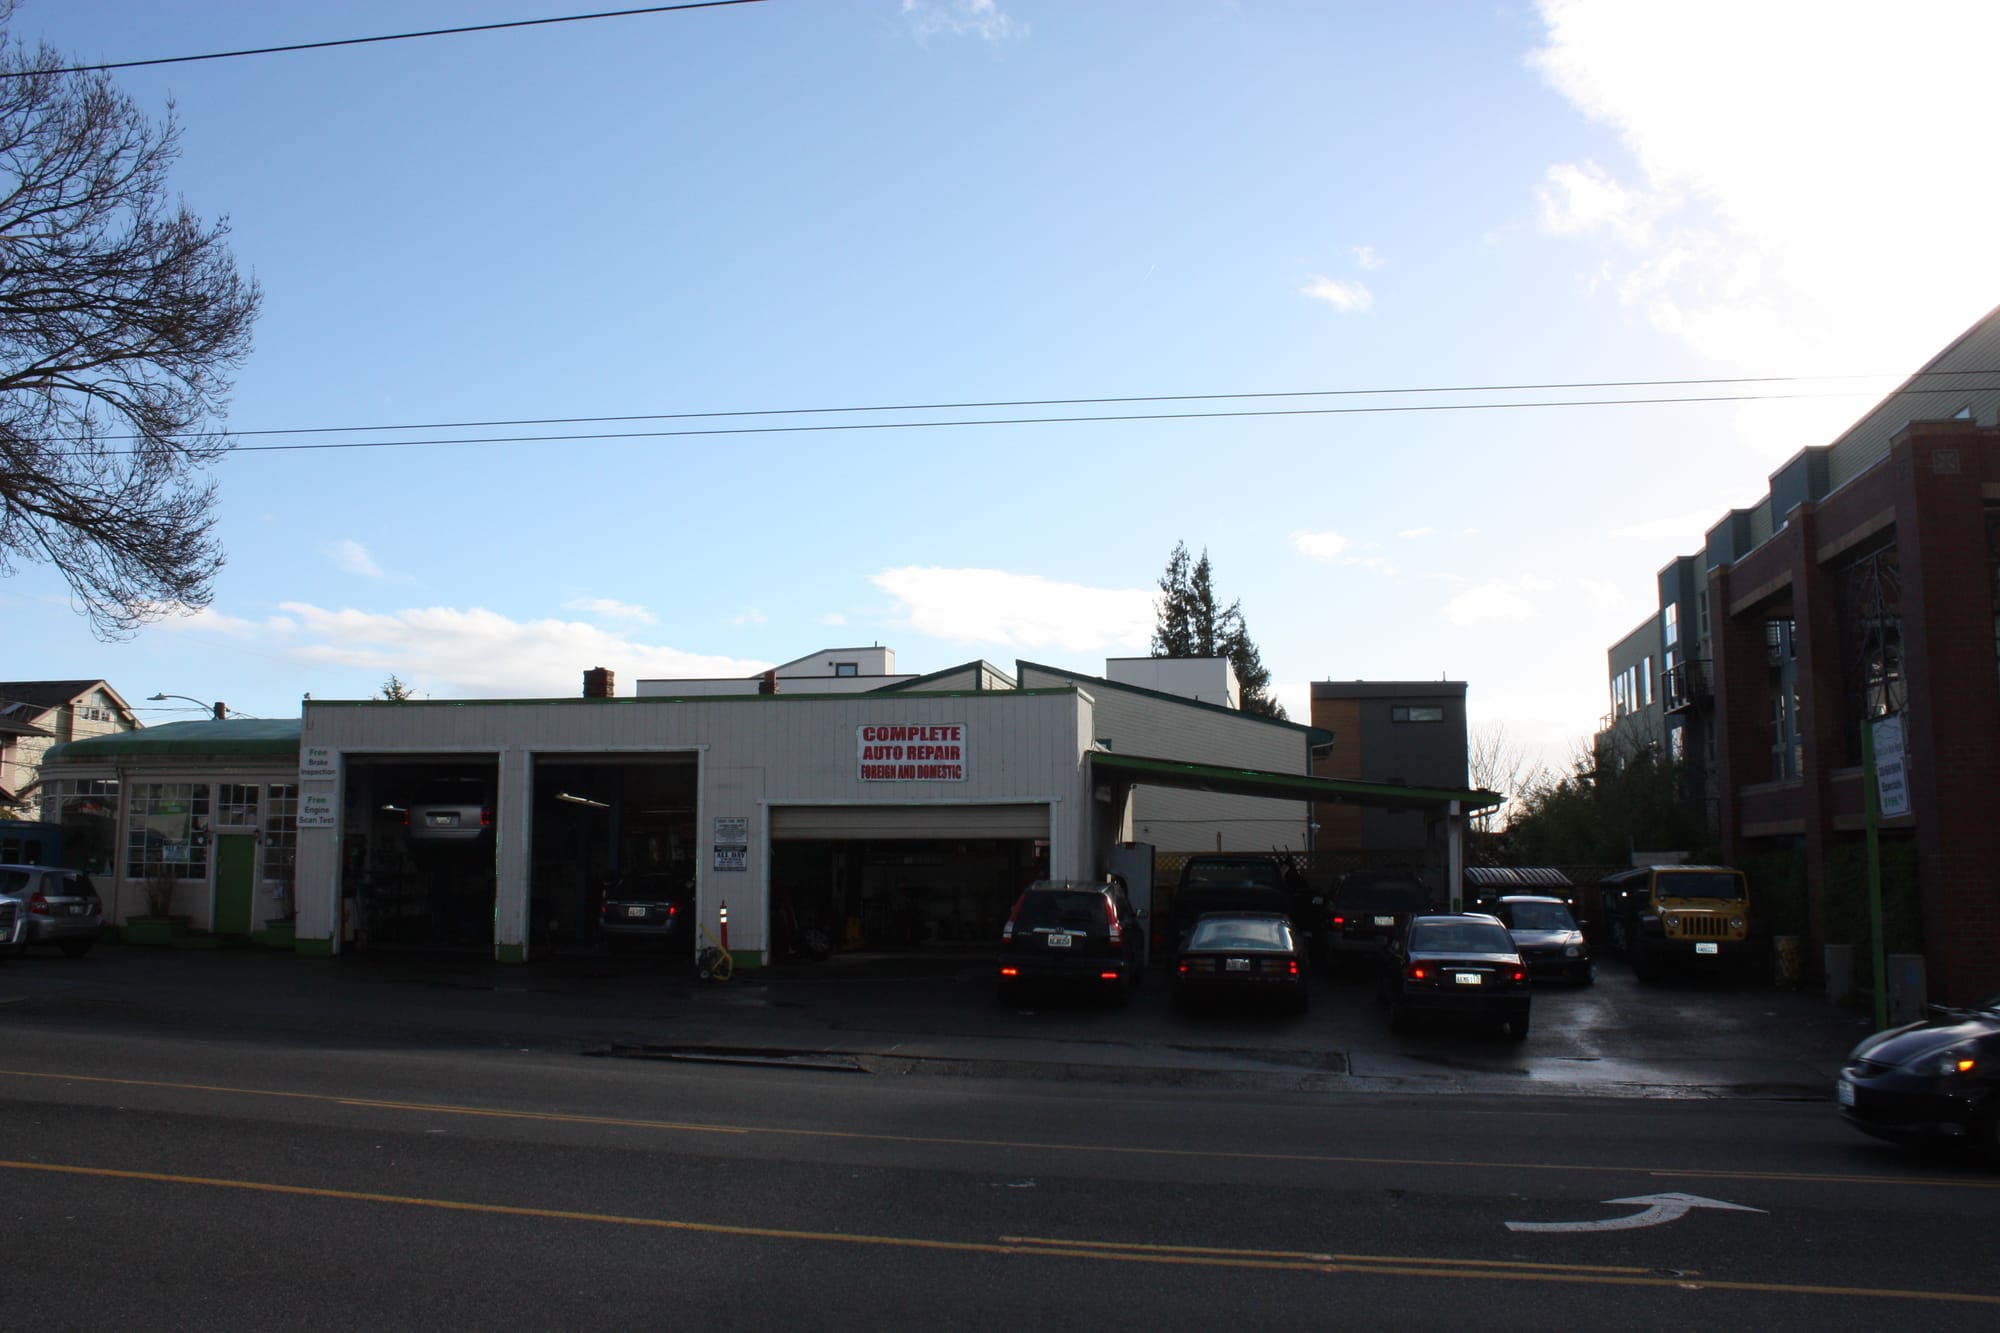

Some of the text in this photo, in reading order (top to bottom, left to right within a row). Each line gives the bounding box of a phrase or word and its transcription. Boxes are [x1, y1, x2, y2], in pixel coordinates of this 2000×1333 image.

[863, 726, 960, 741] COMPLETE
[863, 745, 960, 760] AUTO REPAIR
[861, 764, 961, 779] FOREIGN AND DOMESTIC
[307, 796, 327, 804] Free
[304, 806, 329, 815] Engine
[299, 816, 335, 824] Scan Test
